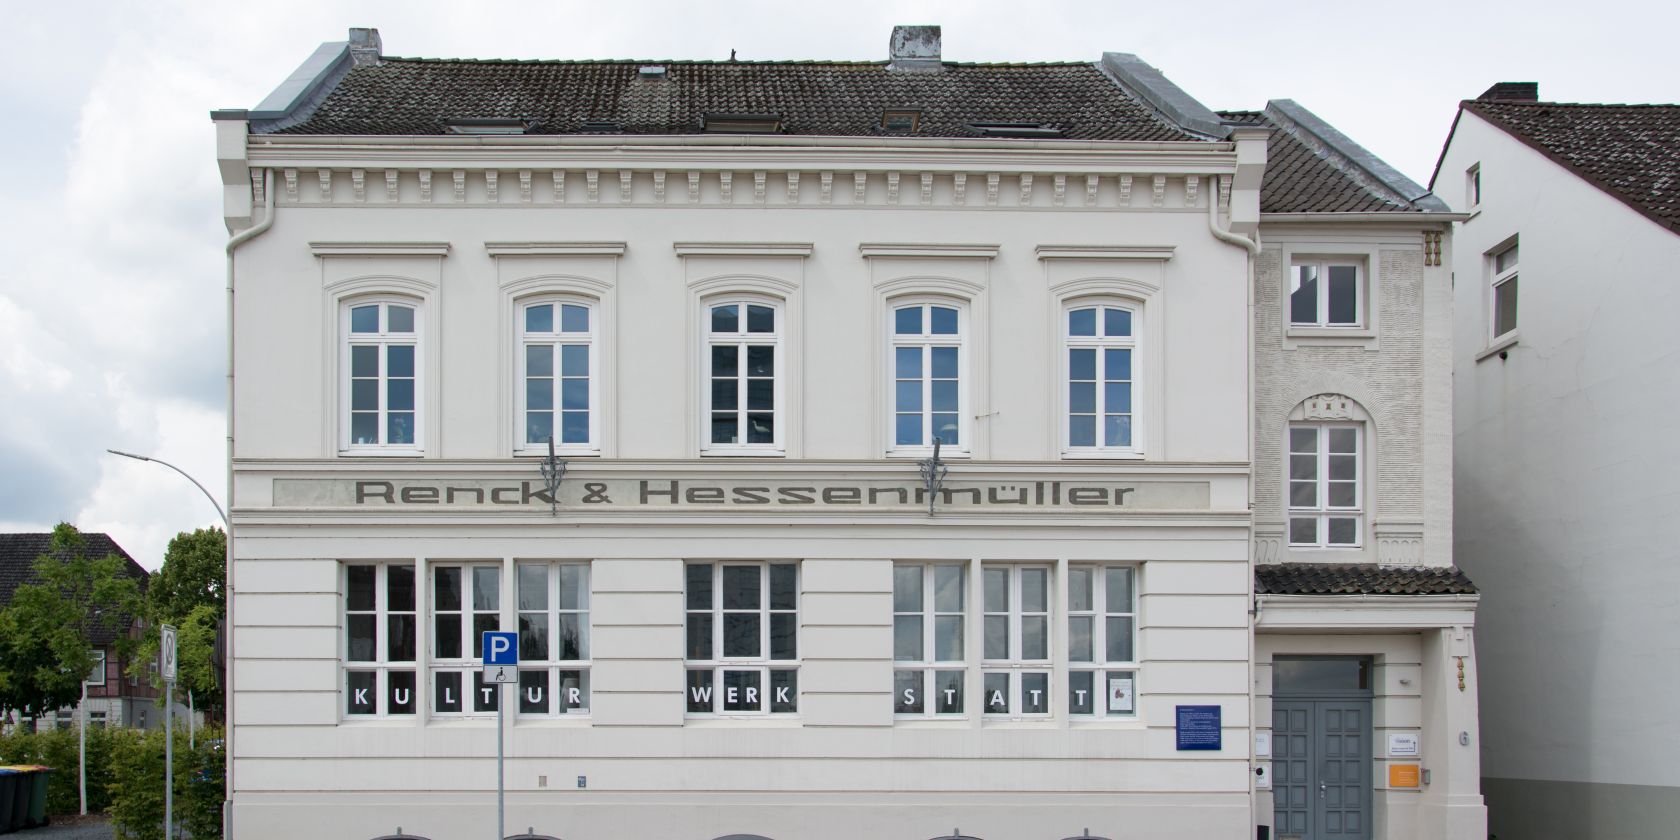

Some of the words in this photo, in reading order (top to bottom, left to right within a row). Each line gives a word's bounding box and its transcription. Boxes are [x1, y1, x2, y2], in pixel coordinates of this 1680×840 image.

[355, 481, 561, 504] Renck
[581, 482, 613, 504] &
[638, 480, 1134, 506] Hessenmüller
[491, 636, 510, 662] P
[1458, 730, 1470, 746] 6
